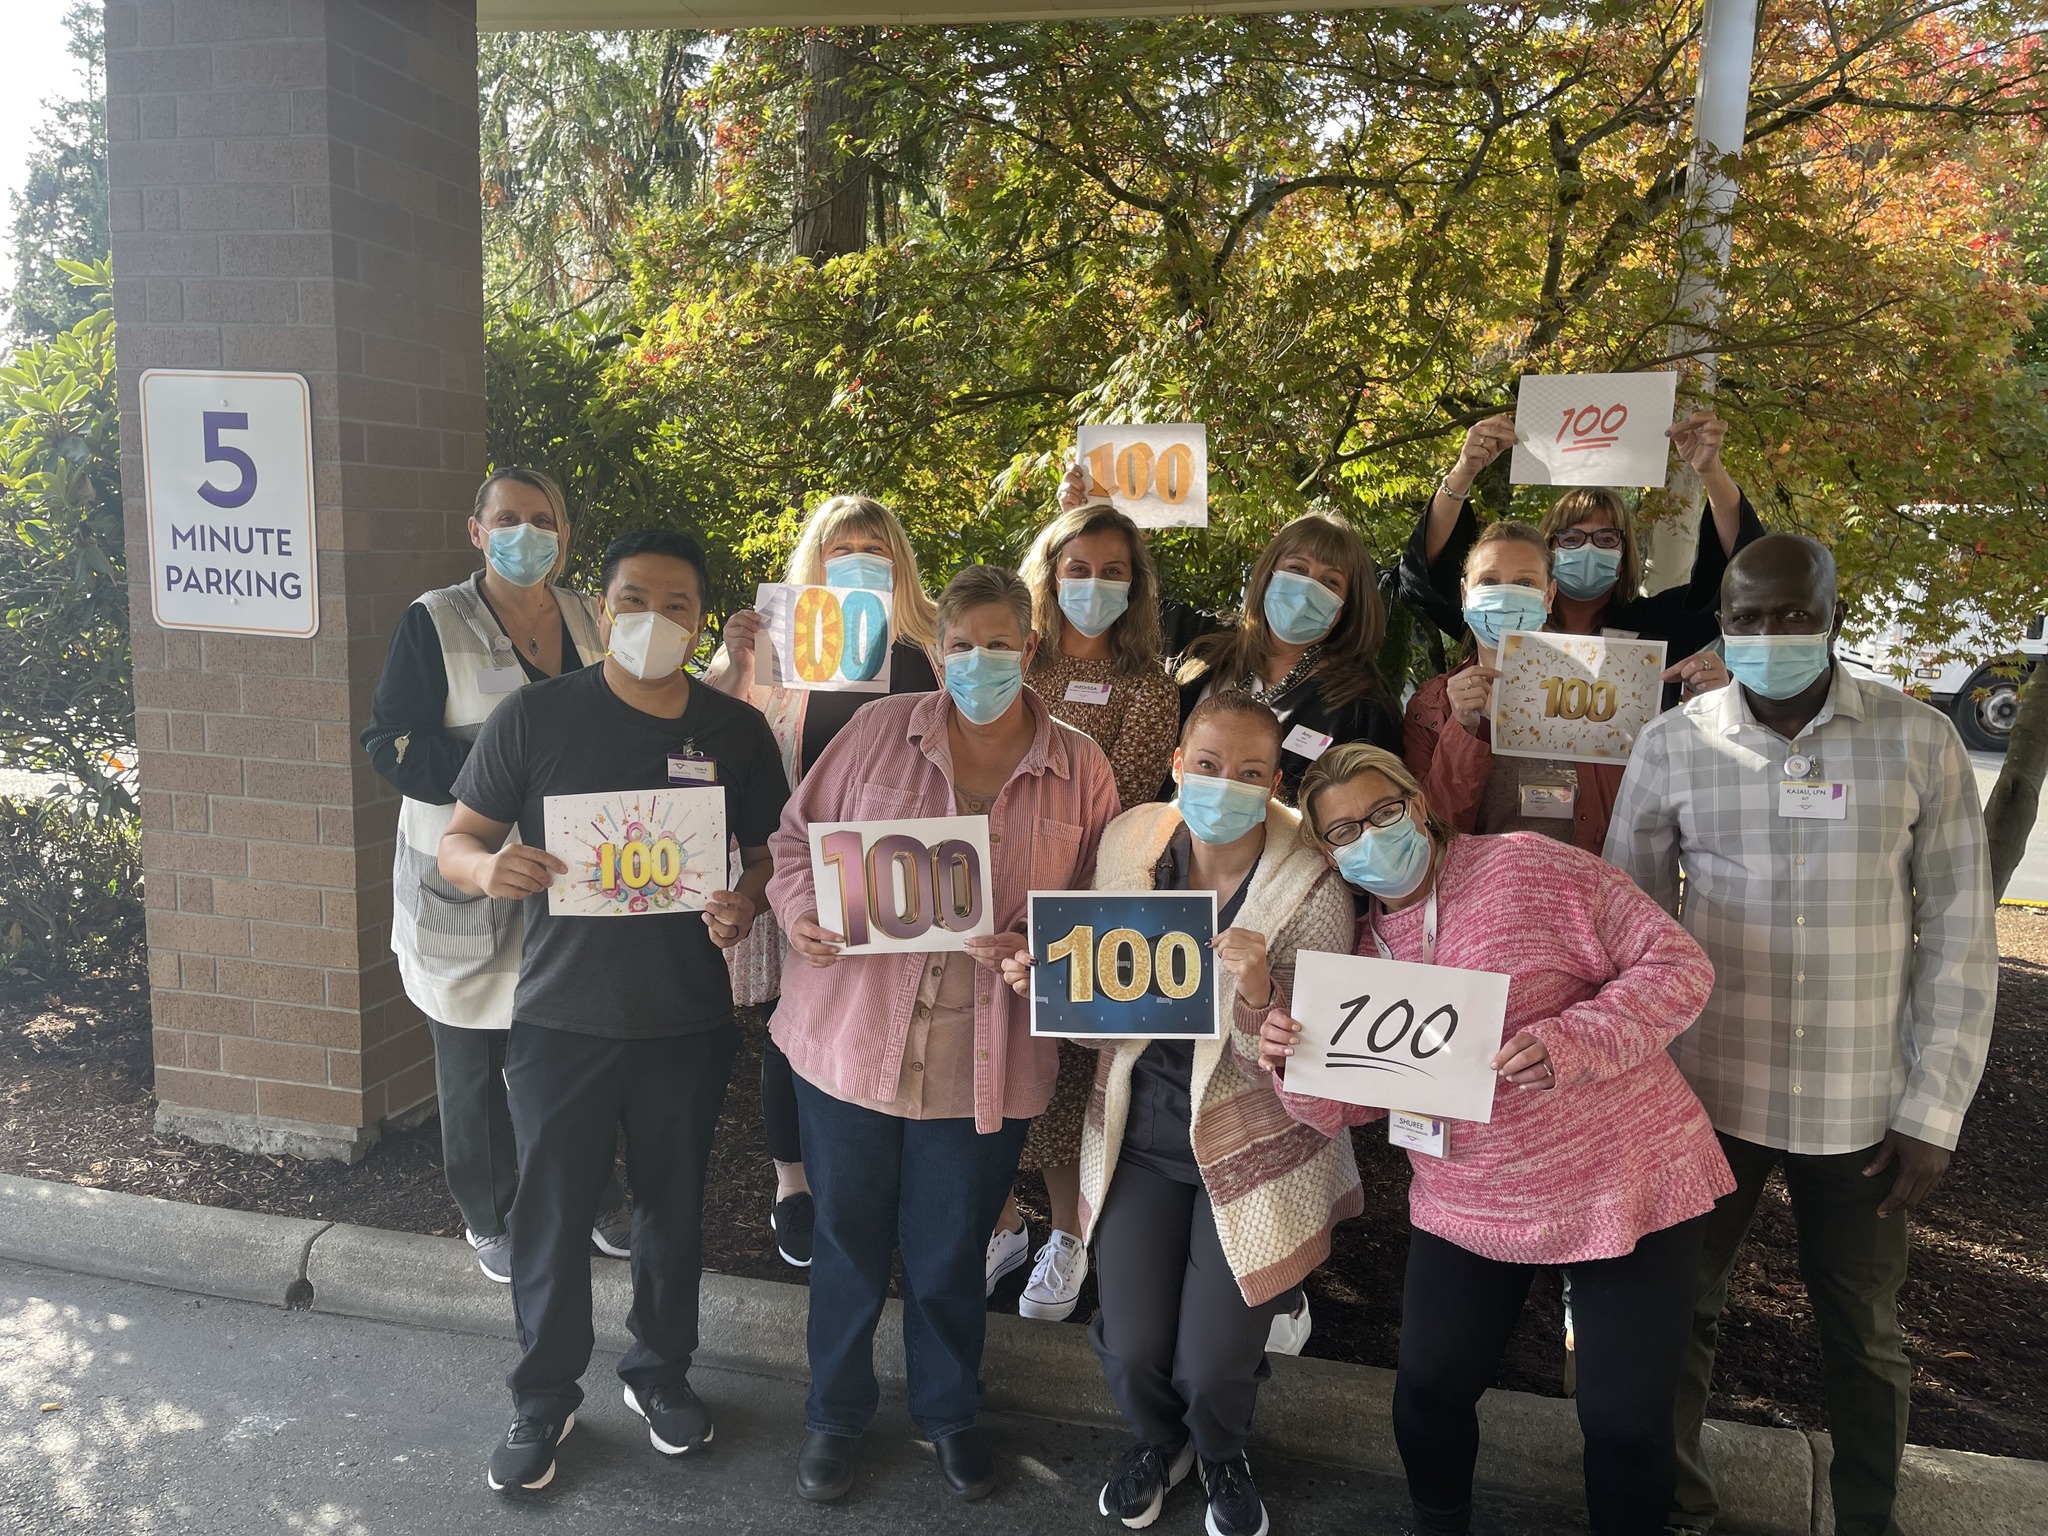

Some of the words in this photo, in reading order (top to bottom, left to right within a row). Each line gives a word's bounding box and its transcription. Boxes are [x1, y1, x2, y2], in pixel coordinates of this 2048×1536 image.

[1556, 403, 1628, 444] 100
[197, 411, 258, 509] 5
[1084, 442, 1196, 505] 100
[171, 523, 293, 557] MINUTE
[166, 565, 302, 600] PARKING
[757, 586, 888, 683] 100
[1539, 676, 1619, 722] 100
[600, 839, 681, 890] 100
[820, 830, 983, 948] 100
[1046, 925, 1202, 1003] 100
[1329, 994, 1460, 1059] 100
[1399, 1117, 1425, 1131] SHUREE
